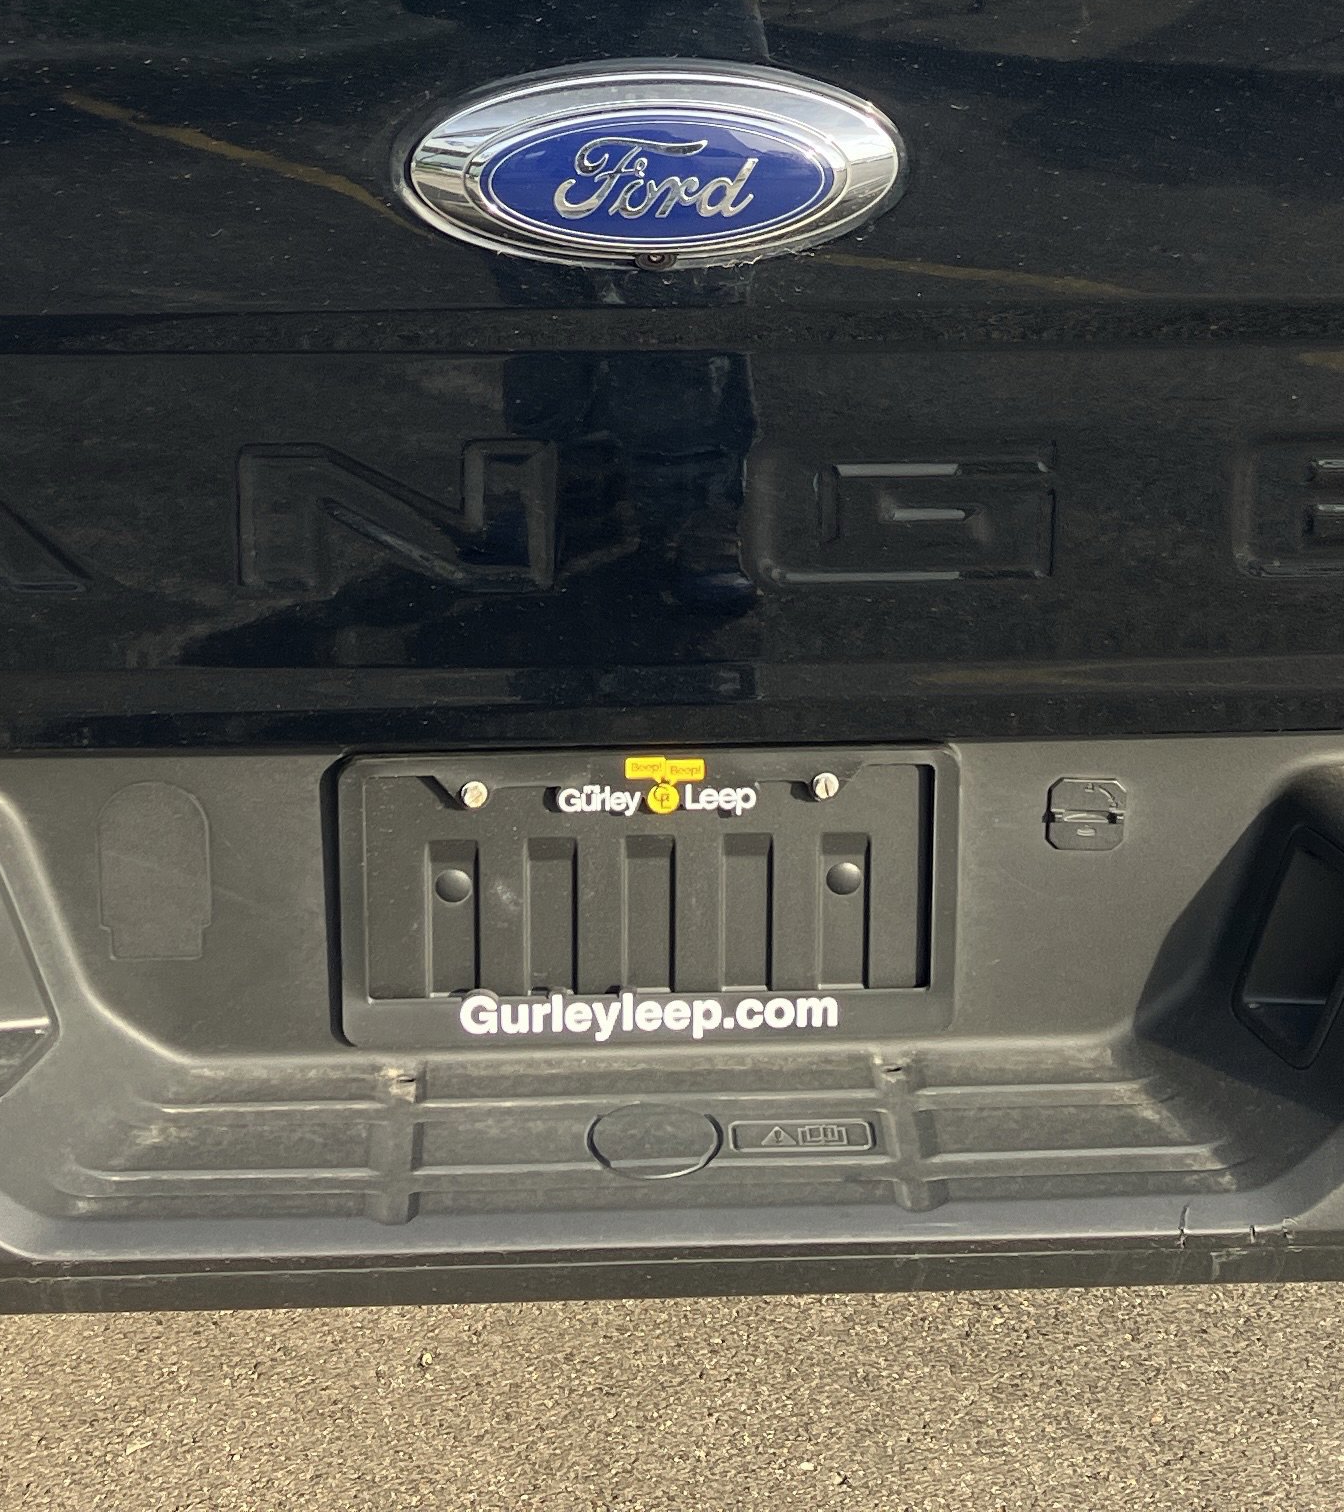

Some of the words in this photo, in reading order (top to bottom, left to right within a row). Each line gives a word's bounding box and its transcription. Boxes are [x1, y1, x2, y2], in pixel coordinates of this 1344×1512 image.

[553, 136, 759, 219] Ford
[631, 762, 662, 774] Beep!
[669, 764, 702, 776] Beep!
[558, 785, 641, 817] Gurley
[685, 783, 757, 816] Leep
[459, 992, 838, 1042] Gurleyleep.com
